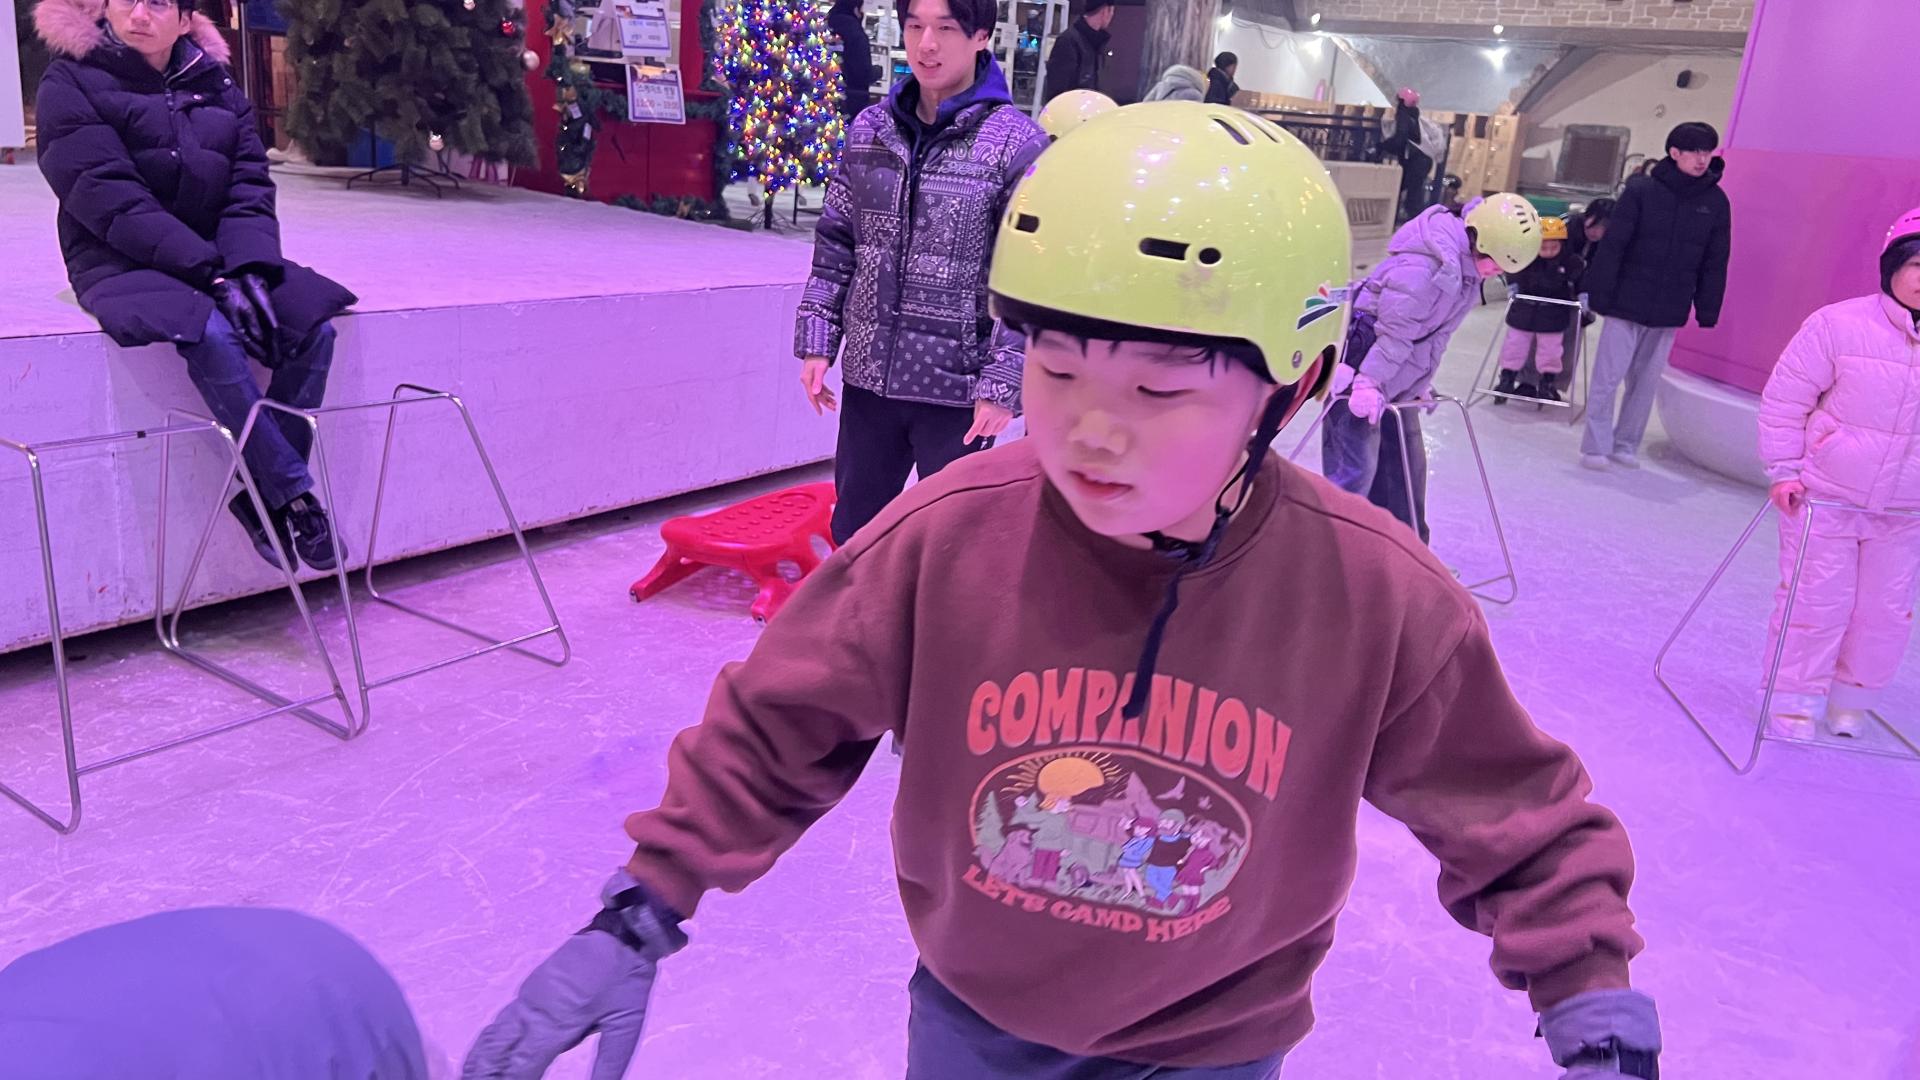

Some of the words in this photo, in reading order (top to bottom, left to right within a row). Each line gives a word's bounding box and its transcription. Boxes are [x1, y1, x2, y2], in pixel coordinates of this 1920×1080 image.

[967, 667, 1292, 801] COMPANION
[1050, 900, 1144, 933] CAMP
[1145, 896, 1232, 943] HERE
